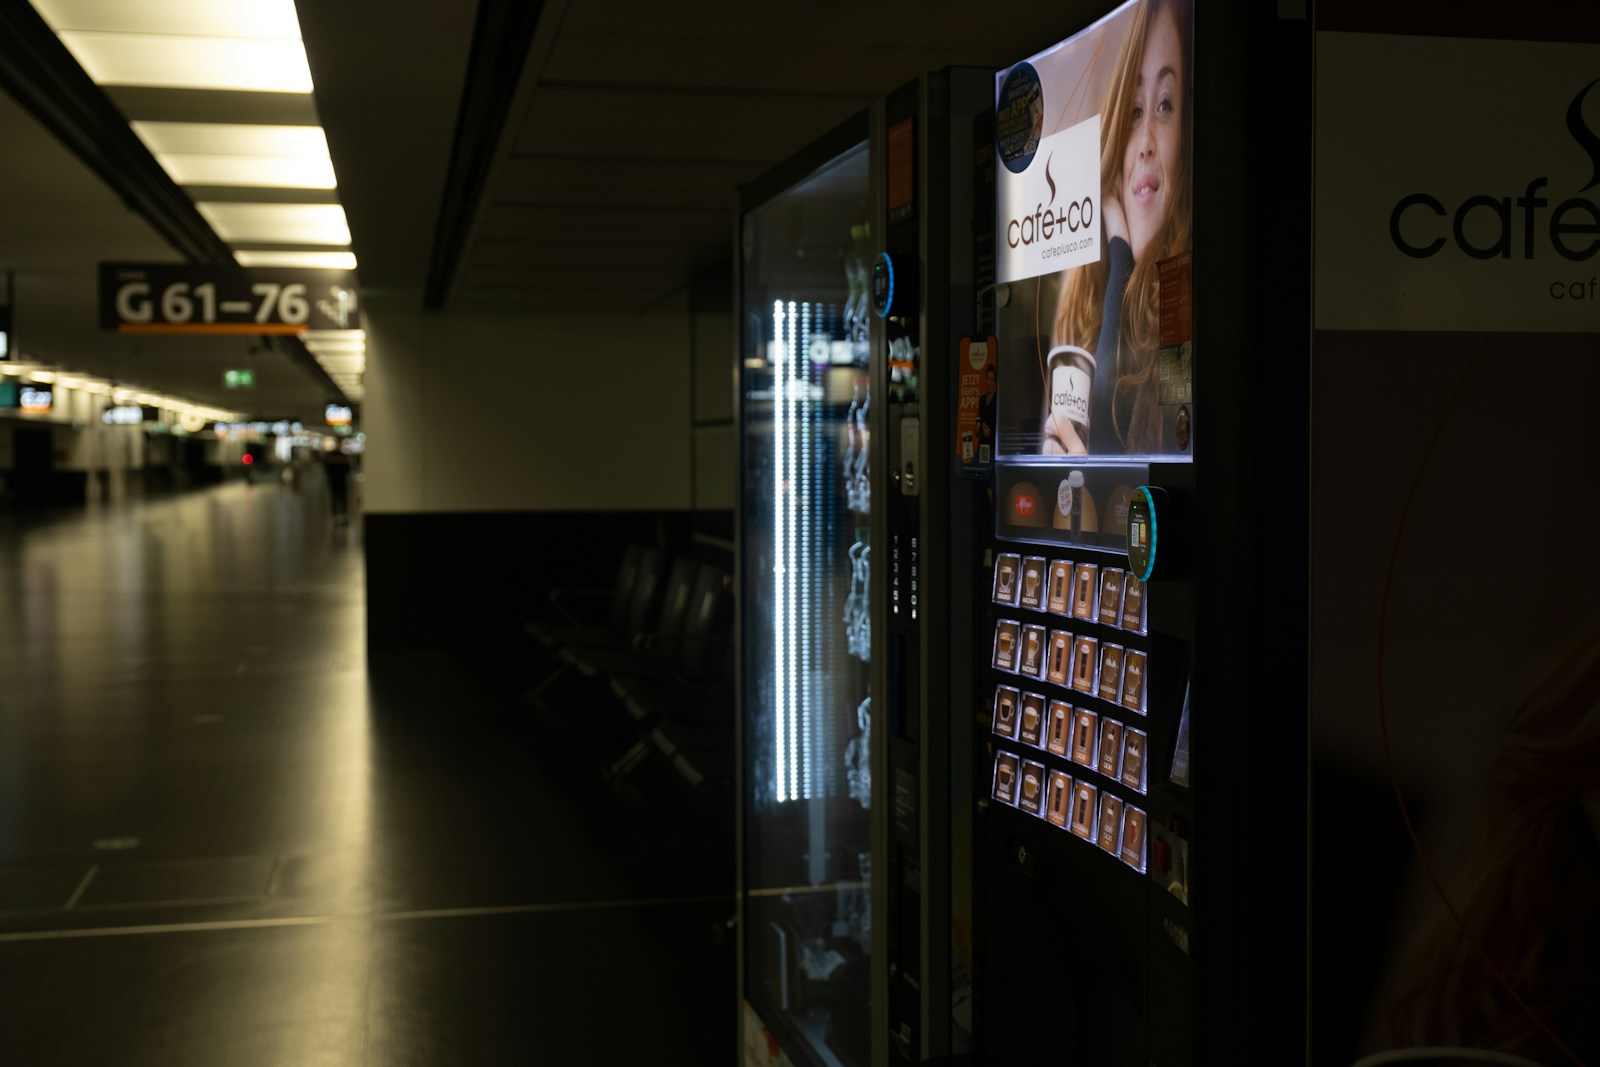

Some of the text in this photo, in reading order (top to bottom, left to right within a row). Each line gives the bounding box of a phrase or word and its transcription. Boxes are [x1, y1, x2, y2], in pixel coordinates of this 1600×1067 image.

[1041, 237, 1094, 260] cafeplusco.com
[1550, 277, 1600, 300] caf
[115, 282, 154, 324] G
